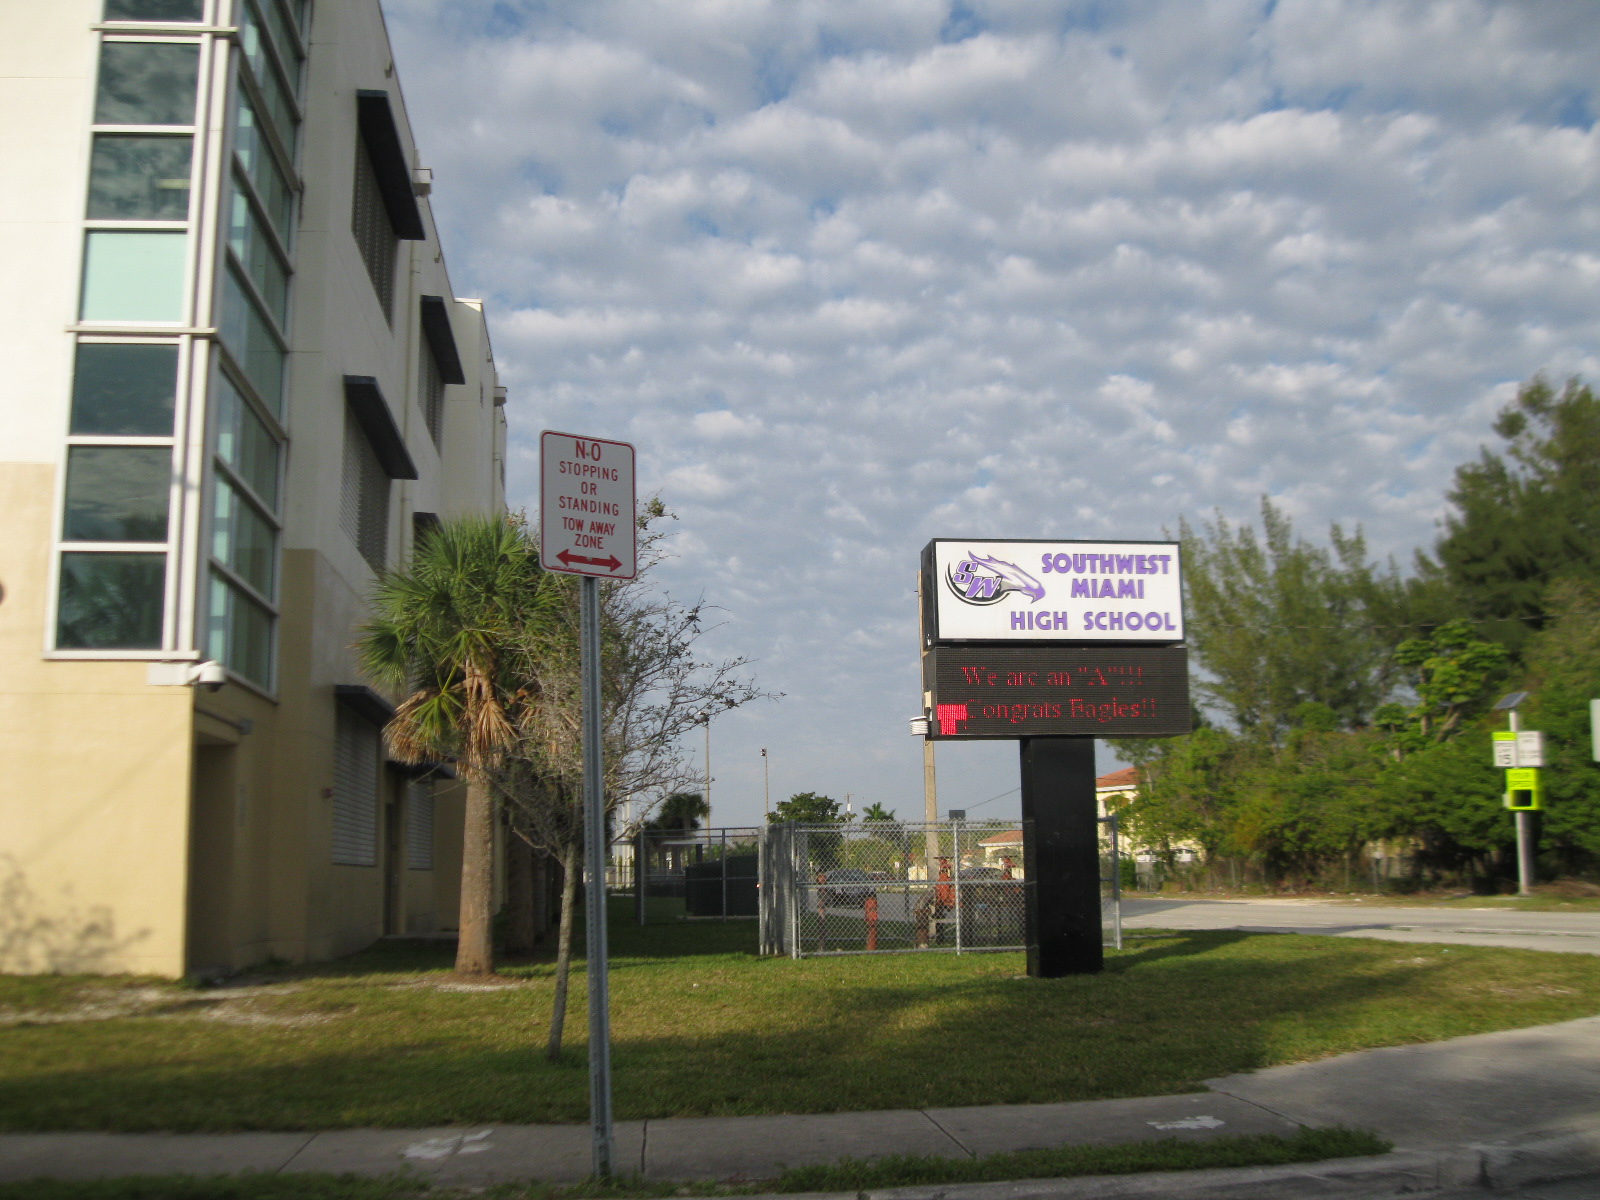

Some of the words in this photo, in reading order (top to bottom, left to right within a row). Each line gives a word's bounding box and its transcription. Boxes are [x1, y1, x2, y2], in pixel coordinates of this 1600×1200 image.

[575, 440, 601, 461] NO
[559, 460, 618, 481] STOPPING
[581, 482, 597, 495] OR
[559, 496, 619, 516] STANDING
[562, 517, 584, 532] TOW
[589, 522, 615, 536] AWAY
[575, 534, 604, 549] ZONE
[1042, 553, 1172, 575] SOUTHWEST
[1071, 578, 1145, 599] MIAMI
[1010, 611, 1068, 631] HIGH
[1083, 611, 1177, 632] SCHOOL
[960, 666, 998, 686] We
[1007, 672, 1038, 686] are
[1047, 672, 1071, 686] an
[965, 698, 1061, 723] Congrats
[1069, 697, 1156, 723] Eagles!!
